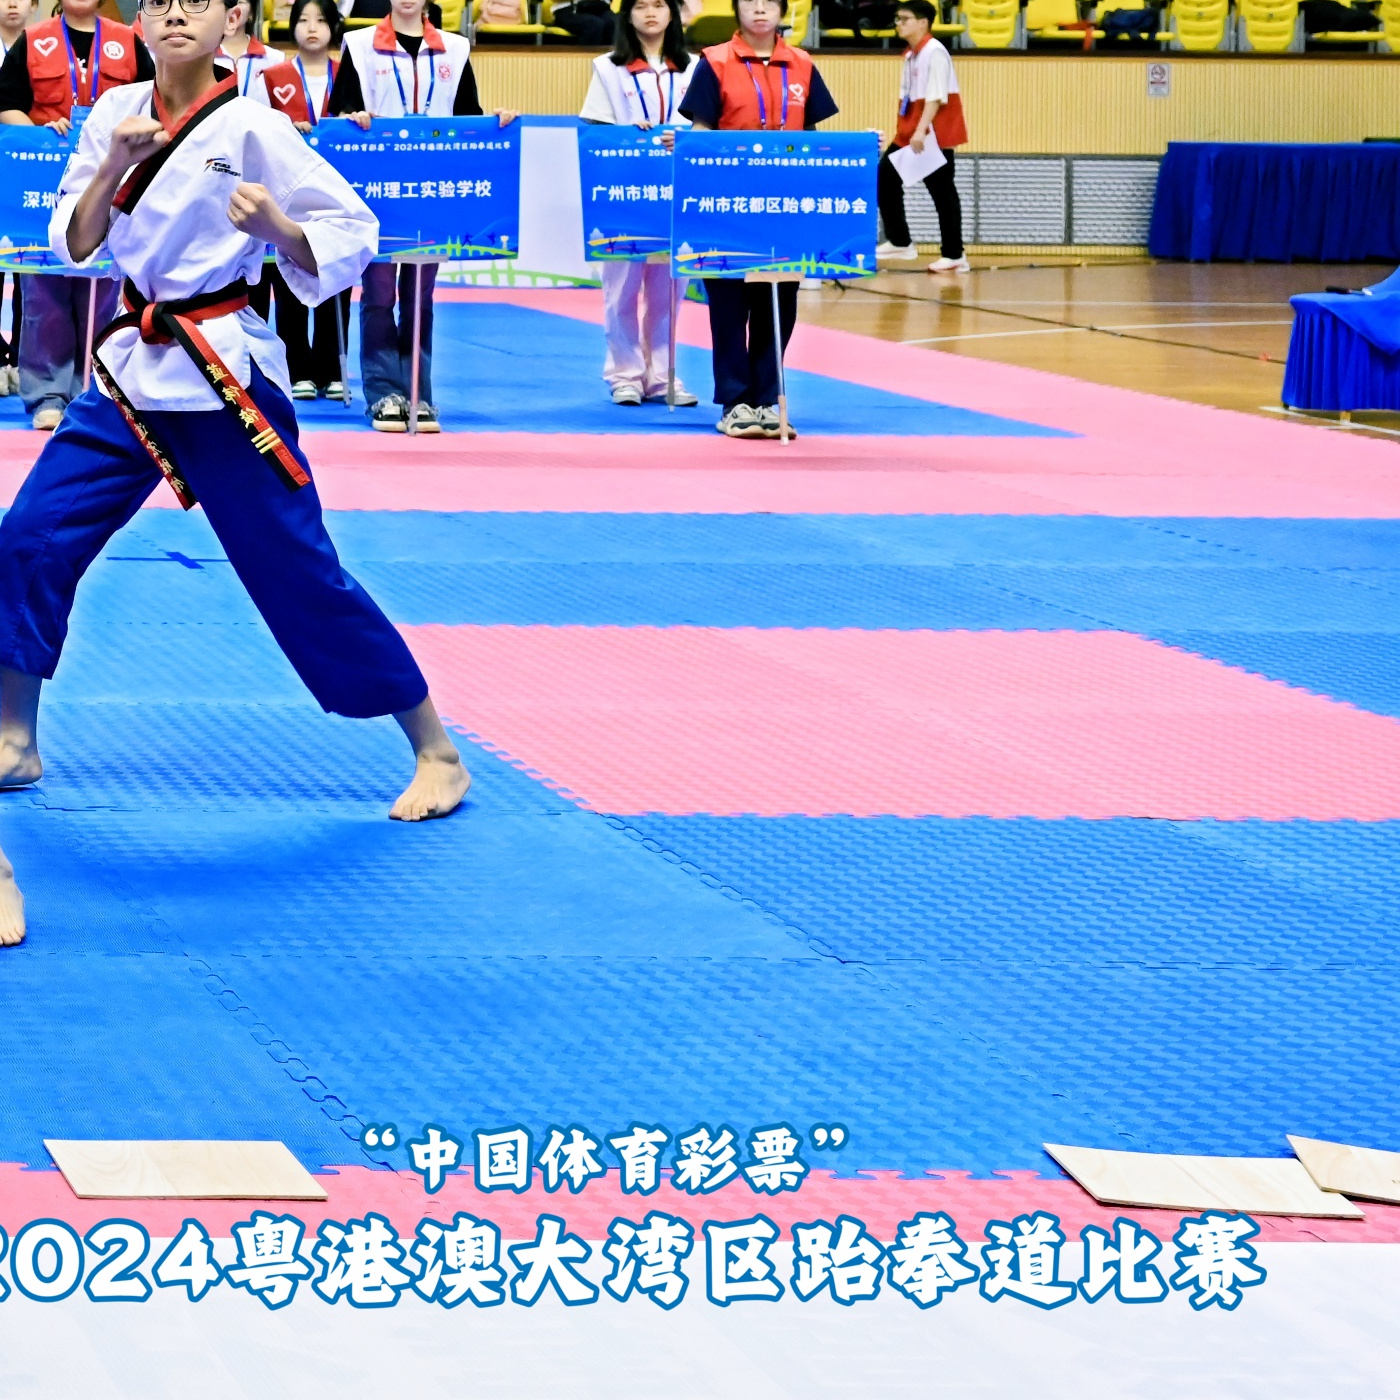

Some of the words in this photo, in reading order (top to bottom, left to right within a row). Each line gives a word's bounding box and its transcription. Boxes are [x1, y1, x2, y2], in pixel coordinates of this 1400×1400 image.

[22, 190, 56, 210] 深圳
[591, 184, 674, 202] 广州市增城
[681, 196, 868, 215] 广州市花都区跆拳道协会
